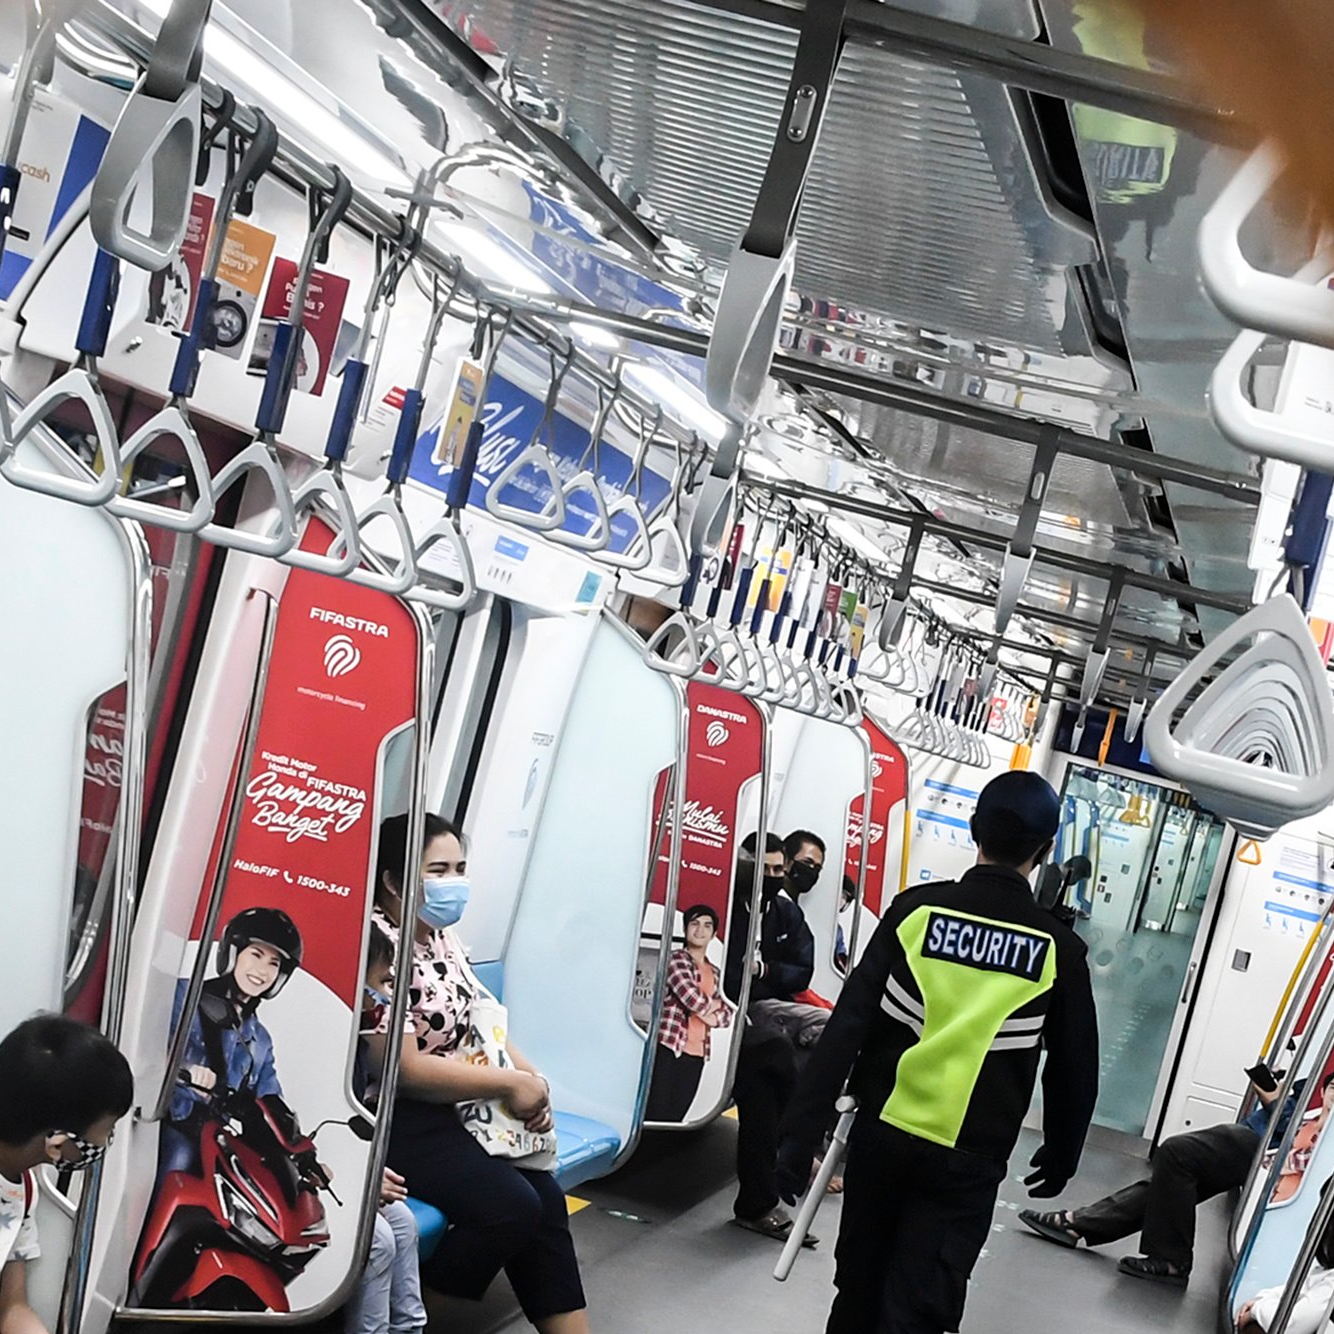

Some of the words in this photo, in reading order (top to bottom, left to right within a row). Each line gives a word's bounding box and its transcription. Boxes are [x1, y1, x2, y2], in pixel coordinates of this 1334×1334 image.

[309, 606, 389, 638] FIFASTRA
[696, 704, 747, 724] DANASTRA
[261, 751, 289, 766] Kredit
[290, 758, 317, 772] Motor
[268, 762, 297, 777] Honda
[298, 771, 309, 779] di
[306, 777, 367, 801] FIFASTRA
[245, 771, 365, 833] Gampang
[252, 801, 336, 843] Banget
[233, 859, 280, 877] HaloFIF
[296, 875, 351, 897] 1500-343
[928, 918, 1045, 973] SECURITY
